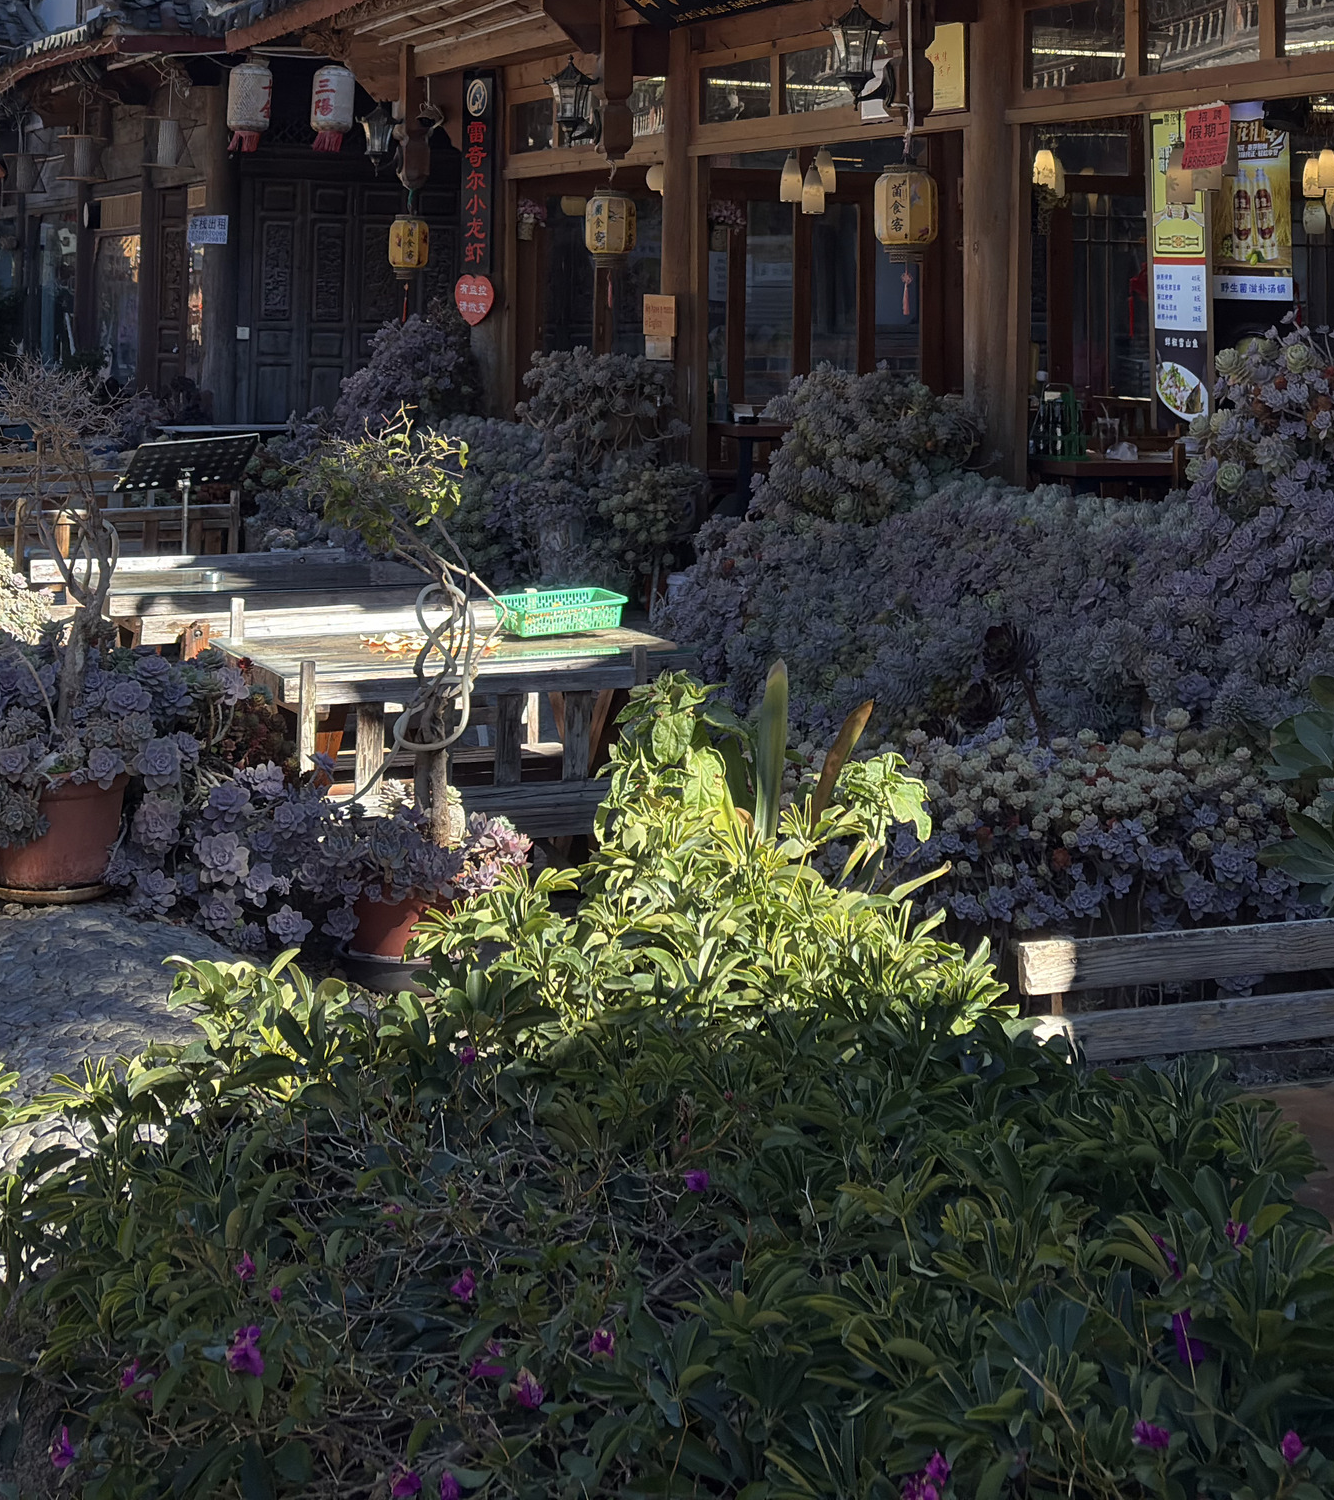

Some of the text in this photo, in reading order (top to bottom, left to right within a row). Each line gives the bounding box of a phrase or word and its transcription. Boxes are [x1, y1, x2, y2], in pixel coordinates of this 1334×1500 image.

[1188, 123, 1229, 141] 假期工
[465, 121, 487, 264] 雷奇尔小龙虾
[890, 183, 906, 232] 菌食客
[190, 217, 226, 230] 客栈出租
[460, 283, 487, 296] 有监控
[1220, 283, 1286, 294] 野生菌滋补汤锅
